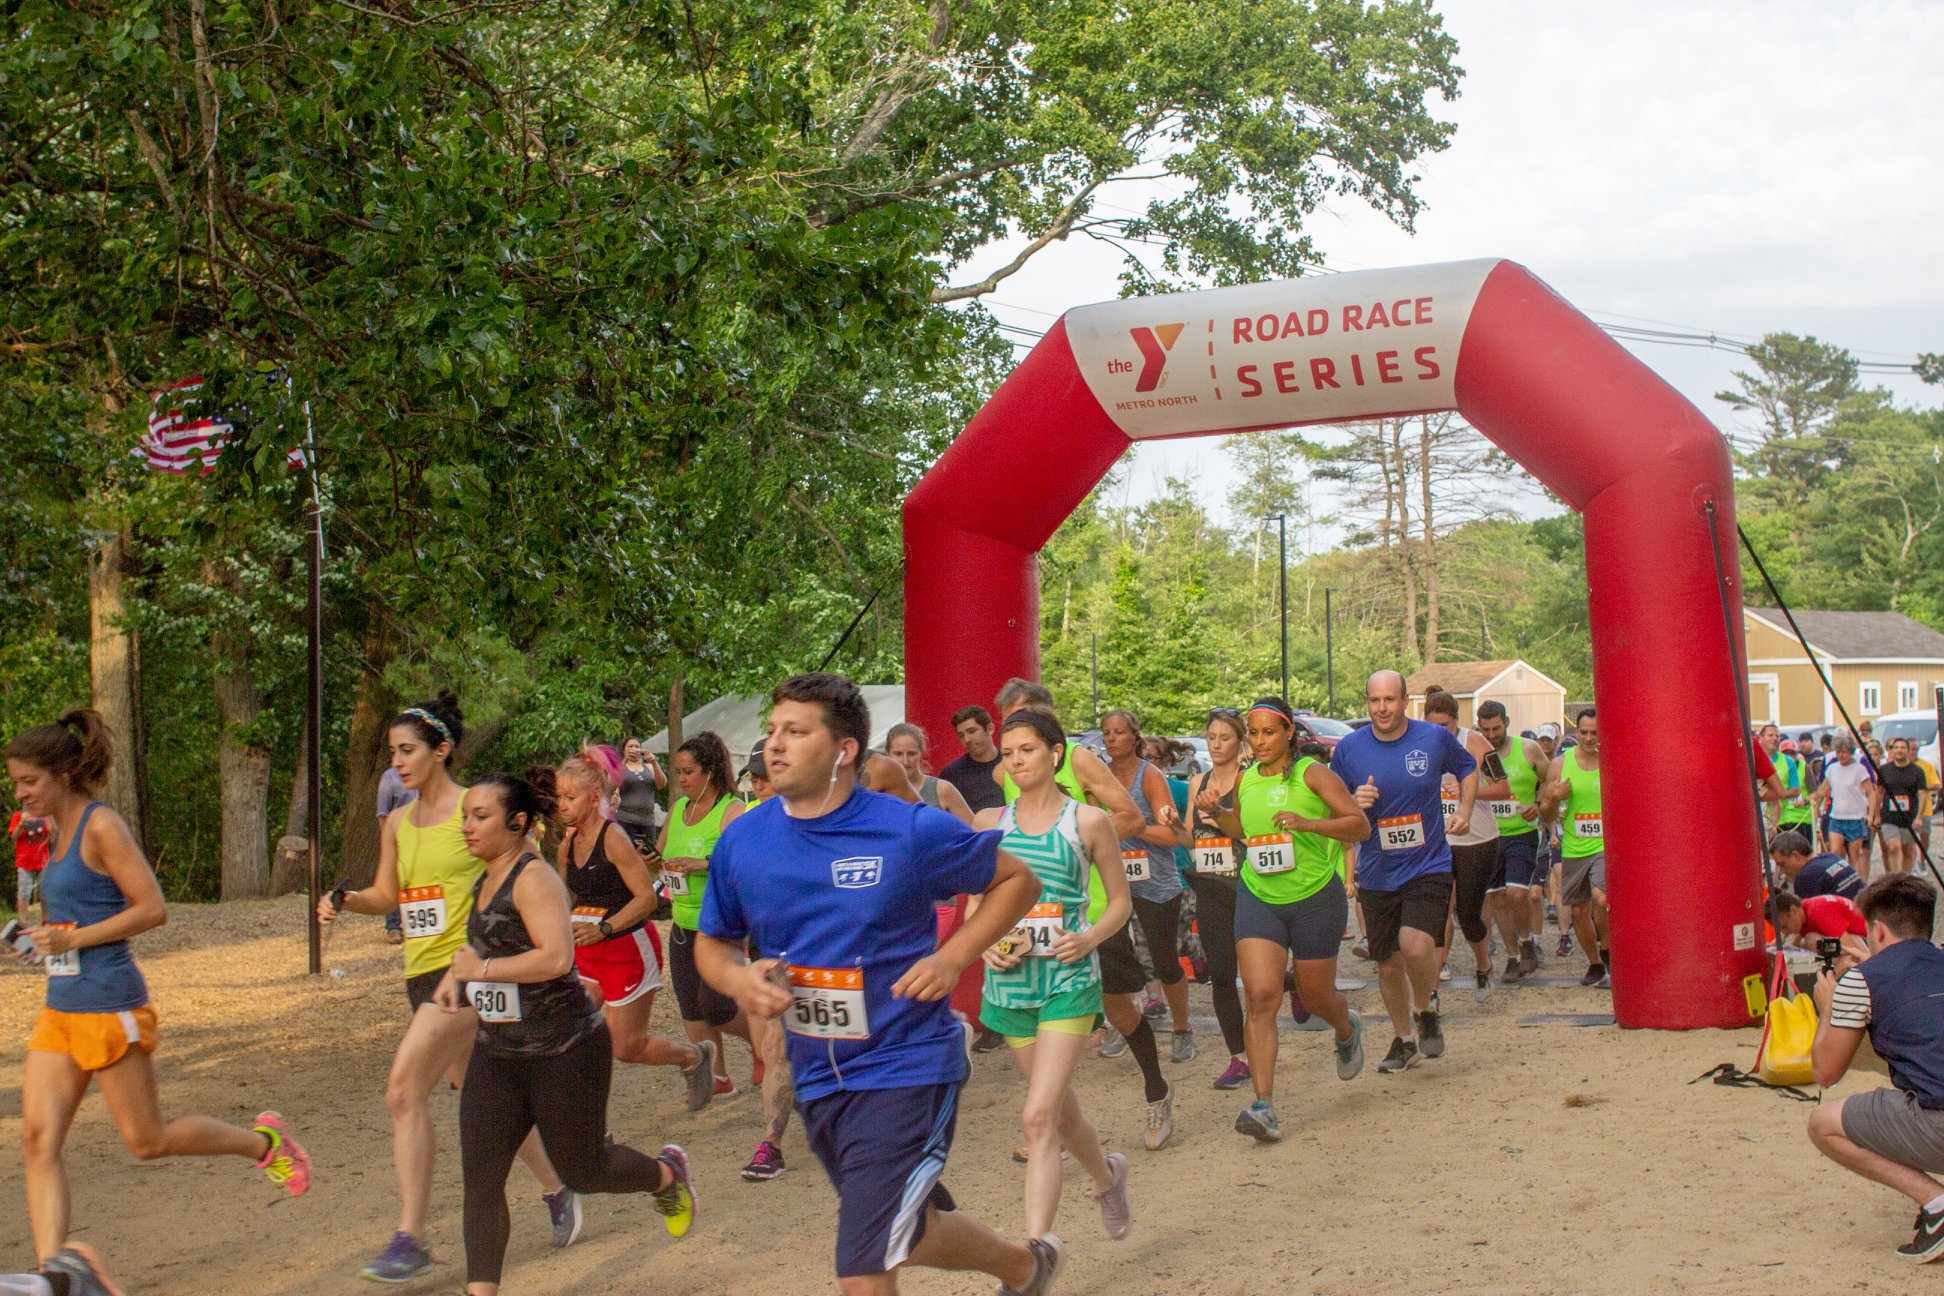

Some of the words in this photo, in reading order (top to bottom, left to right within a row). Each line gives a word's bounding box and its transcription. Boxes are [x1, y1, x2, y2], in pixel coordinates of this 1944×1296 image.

[1233, 309, 1329, 344] ROAD
[1342, 297, 1433, 332] RACE
[1107, 359, 1133, 374] the
[1237, 346, 1440, 398] SERIES
[1116, 399, 1155, 411] METRO
[1158, 395, 1198, 407] NORTH
[1491, 804, 1512, 814] 386
[1580, 823, 1600, 834] 459
[1387, 829, 1416, 845] 552
[1203, 852, 1224, 866] 714
[1258, 850, 1283, 867] 511
[664, 874, 681, 890] 570
[406, 907, 438, 929] 595
[474, 990, 506, 1013] 630
[793, 996, 849, 1027] 565
